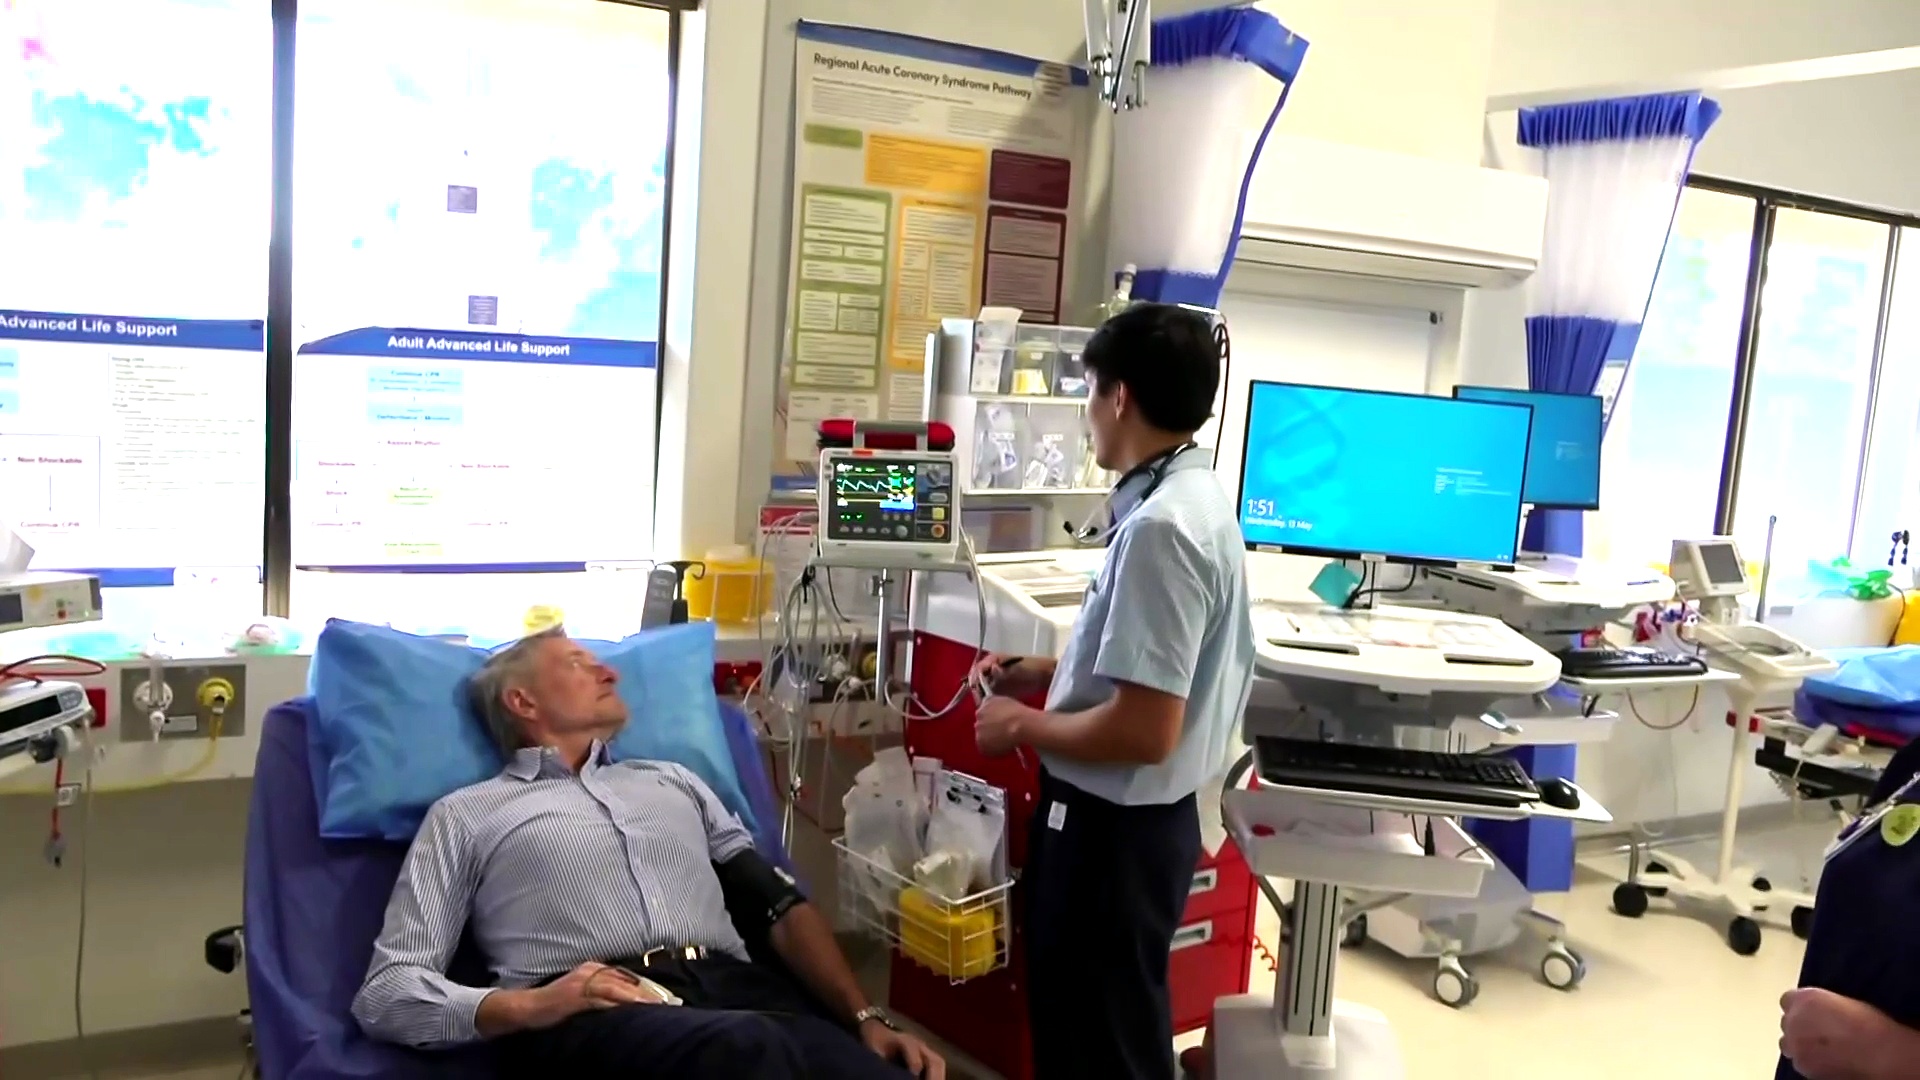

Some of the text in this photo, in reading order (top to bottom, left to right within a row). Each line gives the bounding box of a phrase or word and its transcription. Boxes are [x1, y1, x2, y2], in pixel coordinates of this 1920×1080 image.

[814, 52, 1032, 100] Regional Acute Coronary Syndrome Pathway
[0, 314, 178, 337] Advanced Life Support
[388, 335, 570, 357] Adult Advanced Life Support
[1246, 499, 1274, 517] 1:51
